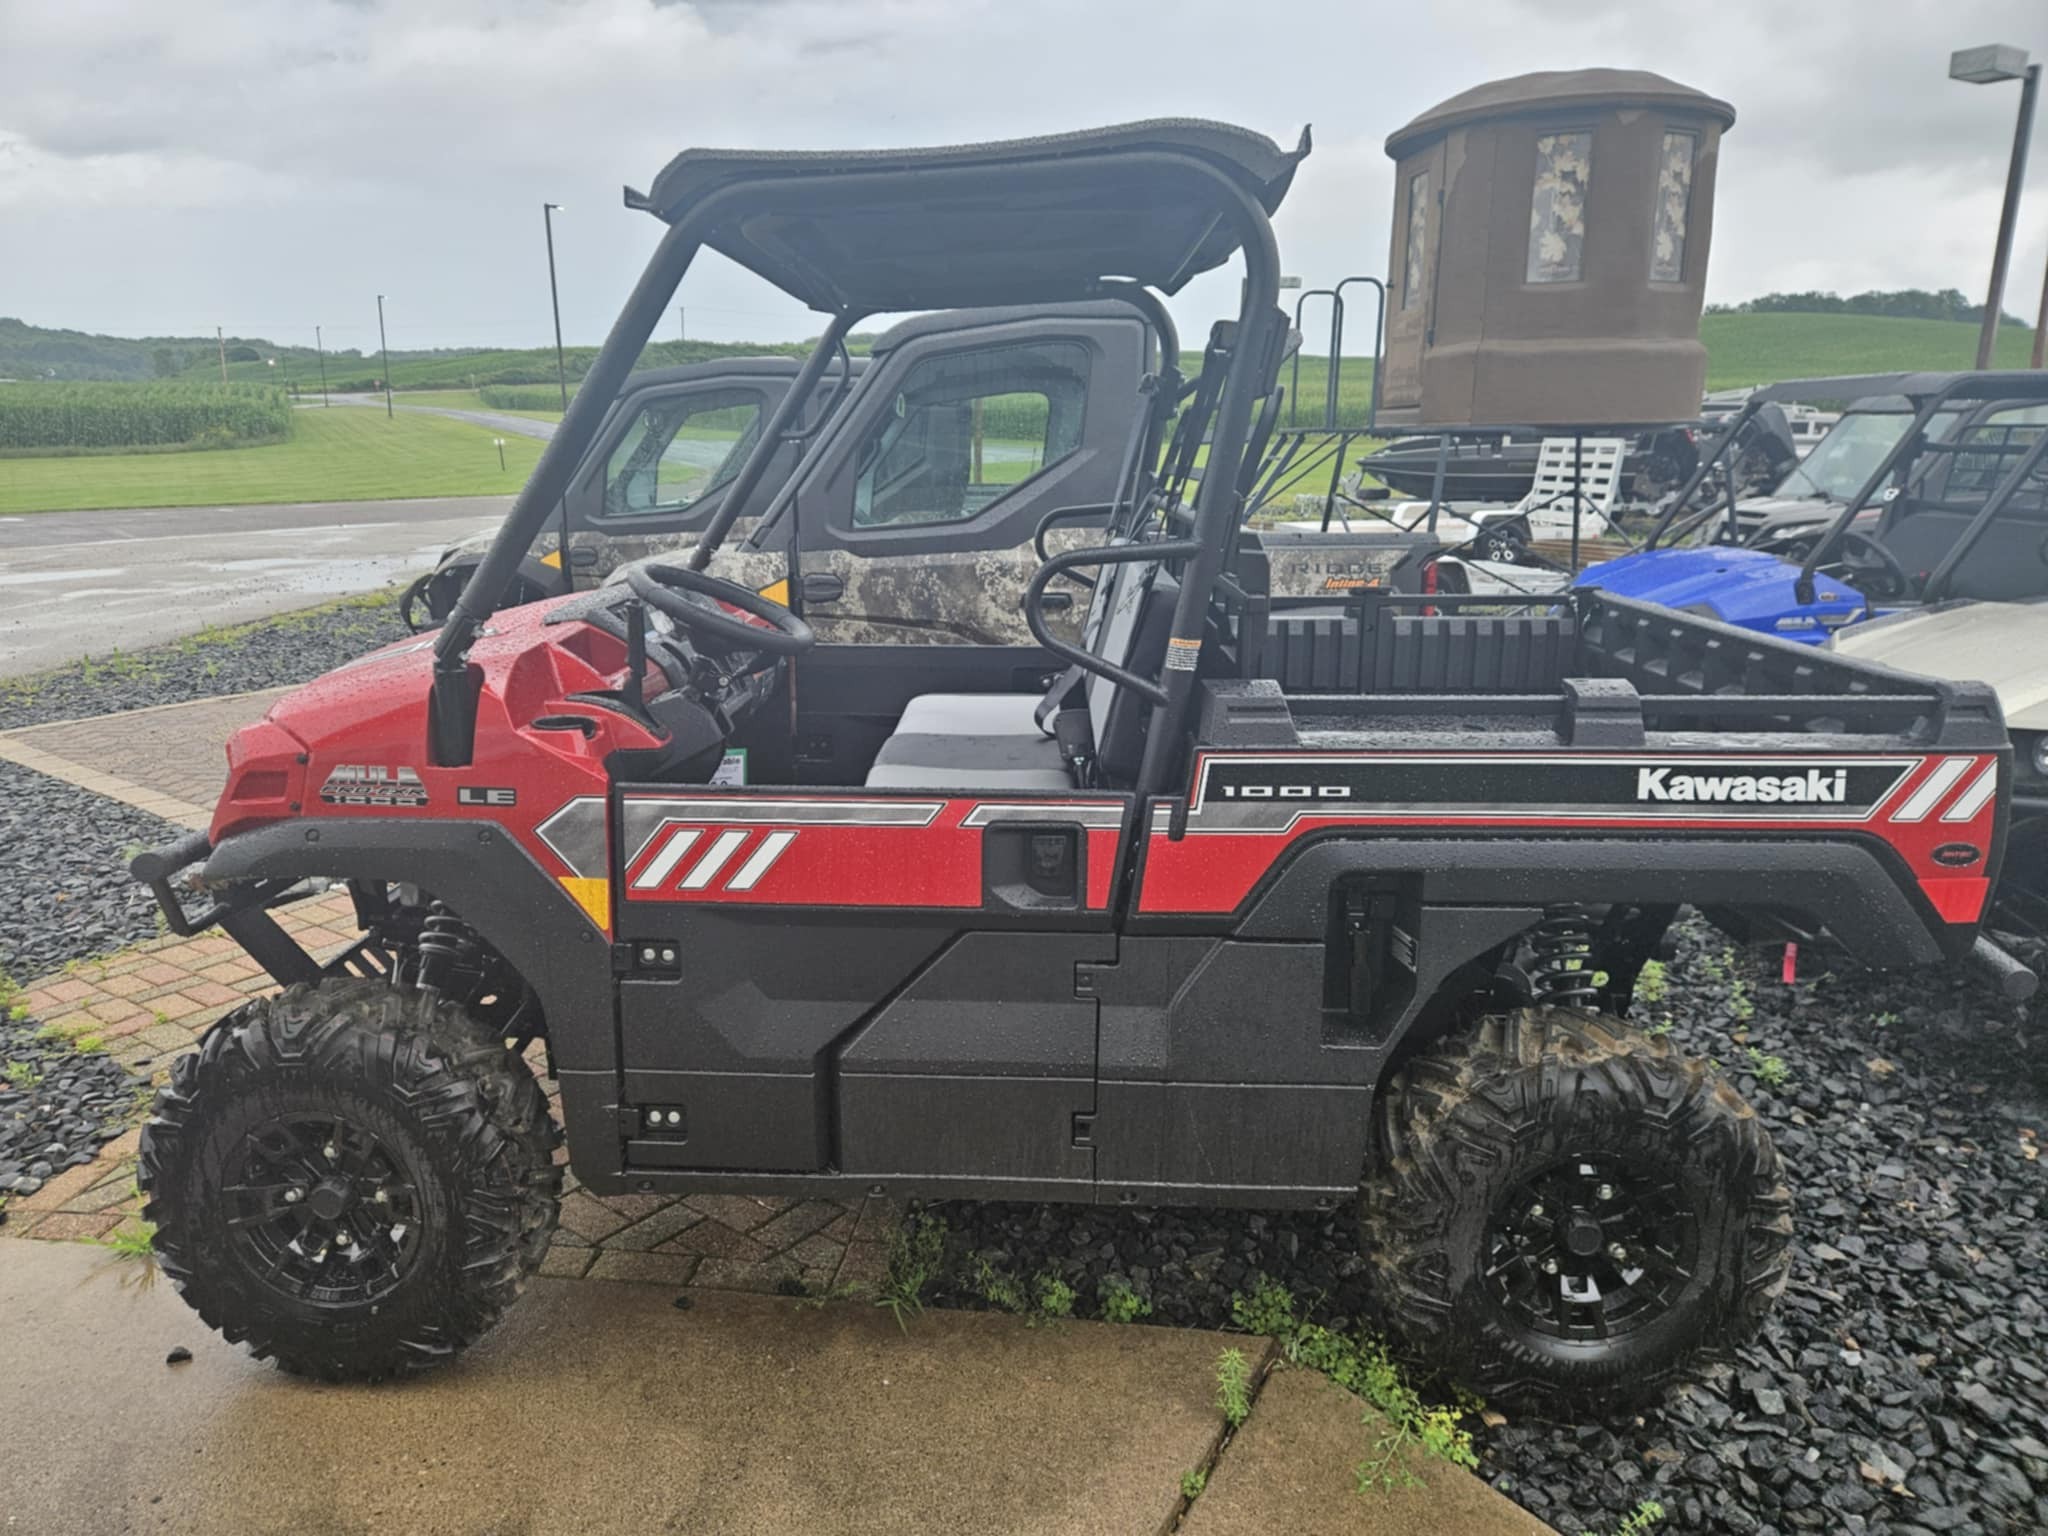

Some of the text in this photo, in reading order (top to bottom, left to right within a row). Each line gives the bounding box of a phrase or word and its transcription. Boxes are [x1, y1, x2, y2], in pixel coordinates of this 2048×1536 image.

[1222, 785, 1351, 797] 1000
[1637, 767, 1847, 803] Kawasaki
[458, 788, 515, 804] LE
